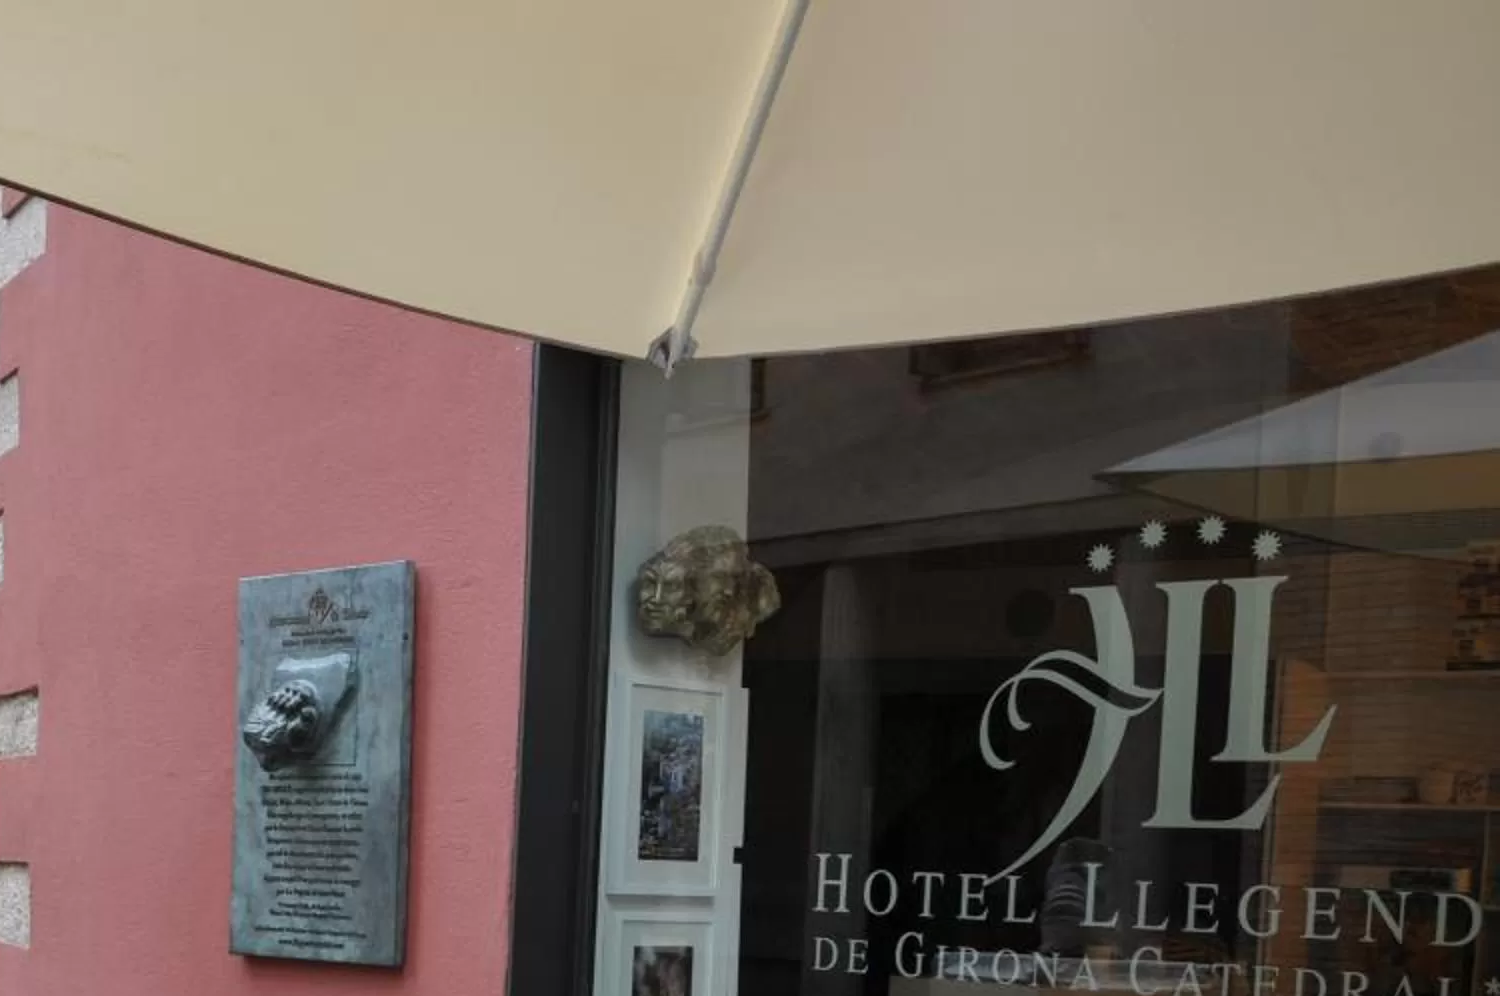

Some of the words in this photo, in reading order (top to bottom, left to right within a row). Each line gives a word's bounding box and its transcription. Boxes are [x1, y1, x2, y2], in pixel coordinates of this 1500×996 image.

[811, 852, 1037, 924] HOTEL
[1078, 861, 1484, 948] LLEGEND
[812, 936, 870, 975] DE
[894, 930, 1099, 993] GIRONA
